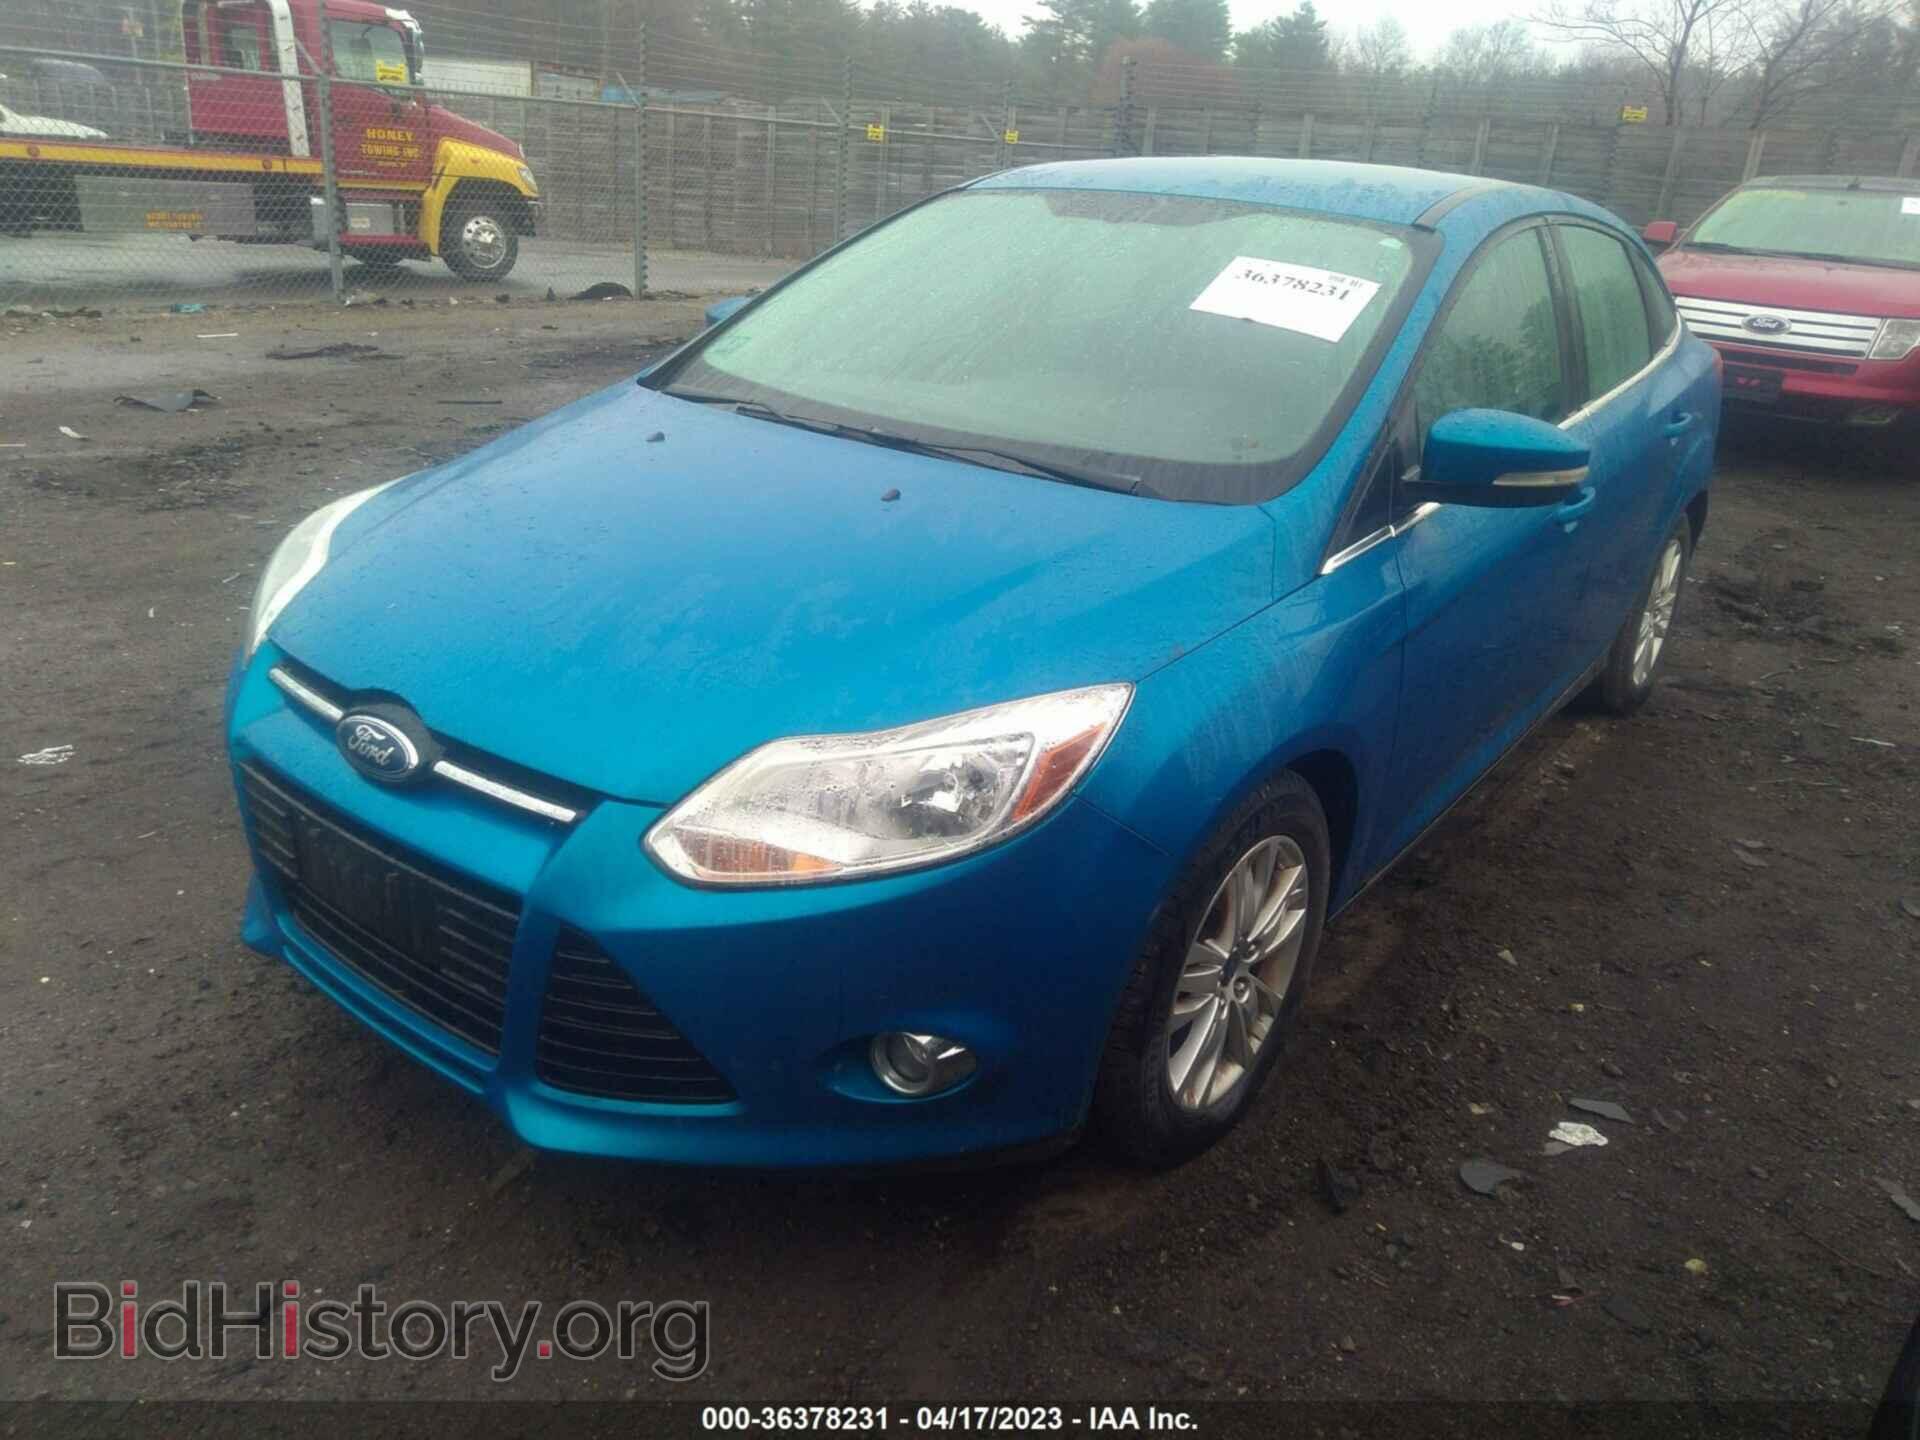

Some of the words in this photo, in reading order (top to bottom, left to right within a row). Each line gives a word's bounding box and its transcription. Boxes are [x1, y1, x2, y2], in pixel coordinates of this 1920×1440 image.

[366, 128, 415, 141] HONEY
[1235, 269, 1350, 301] 36378231
[347, 724, 395, 766] Ford
